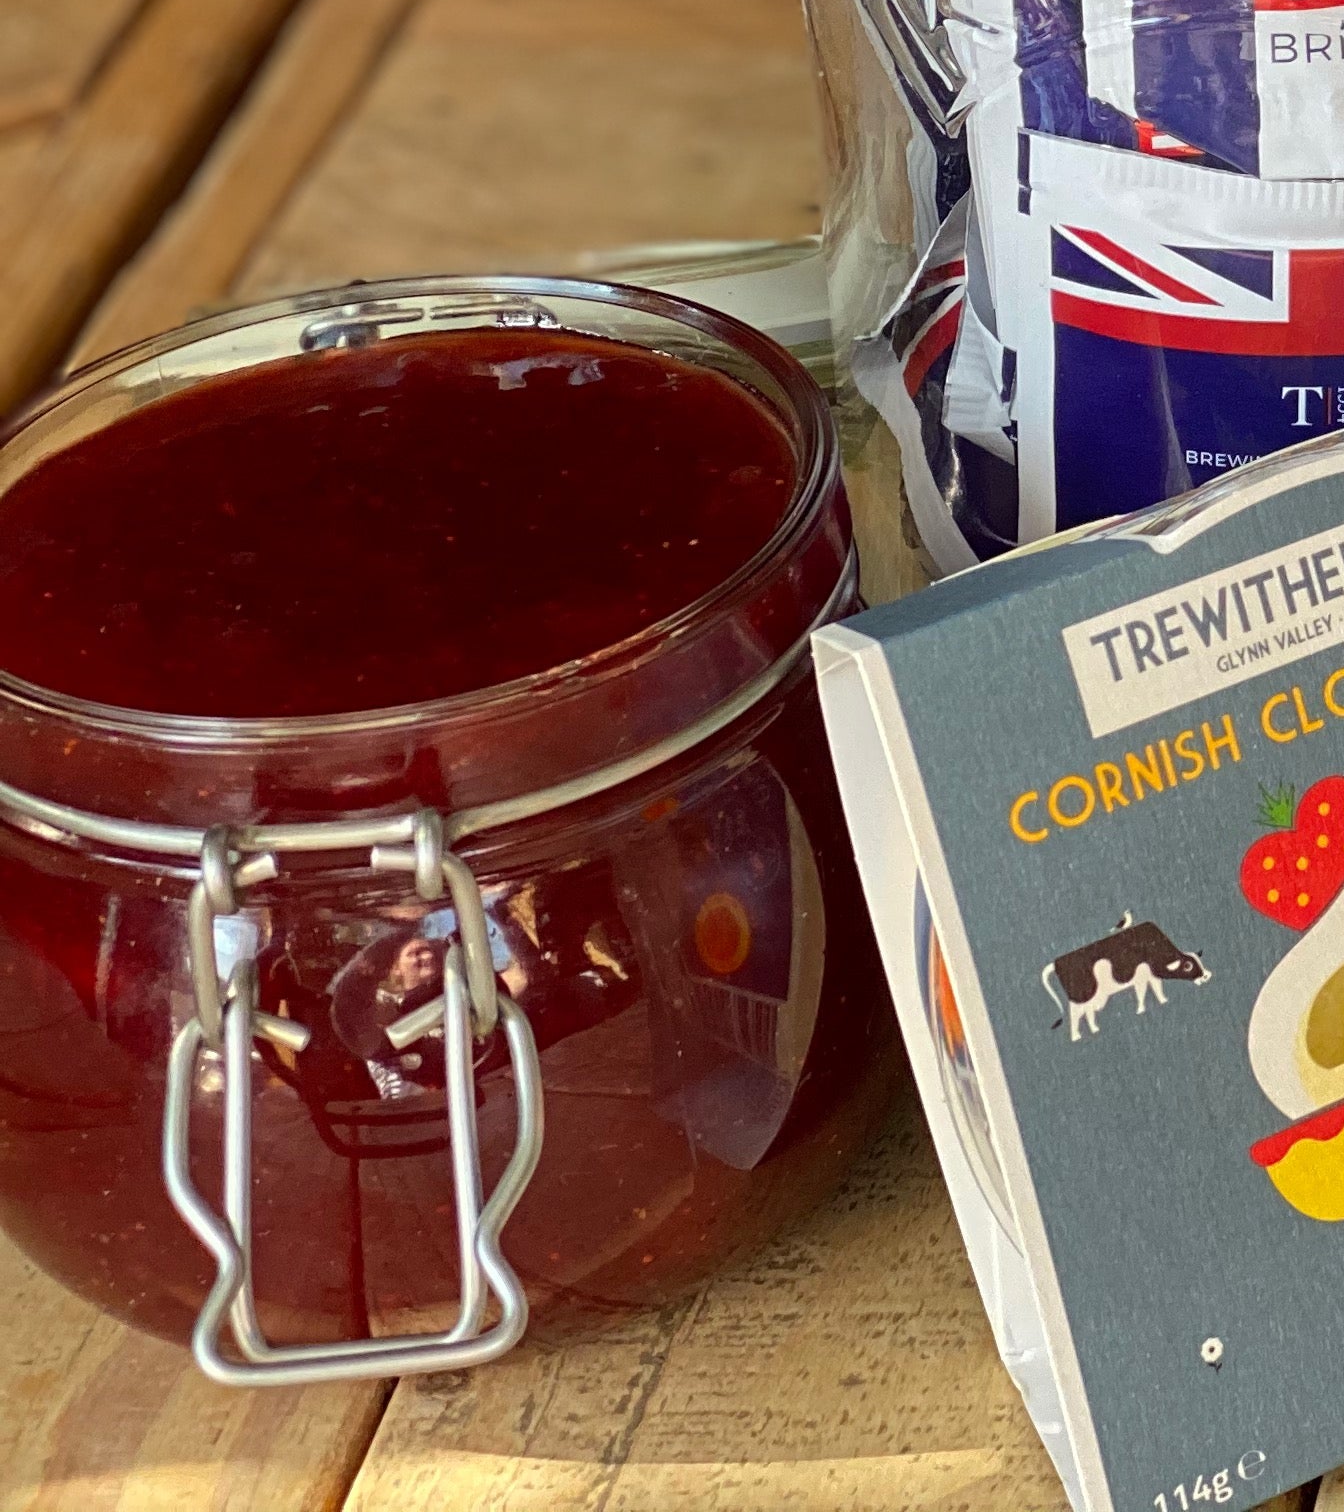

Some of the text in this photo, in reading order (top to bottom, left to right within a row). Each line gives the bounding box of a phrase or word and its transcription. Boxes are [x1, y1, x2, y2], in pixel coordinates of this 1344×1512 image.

[1216, 640, 1270, 673] GLYNN
[1274, 613, 1333, 651] VALLEY
[1009, 715, 1242, 844] CORNISH
[1153, 1468, 1234, 1512] 114g
